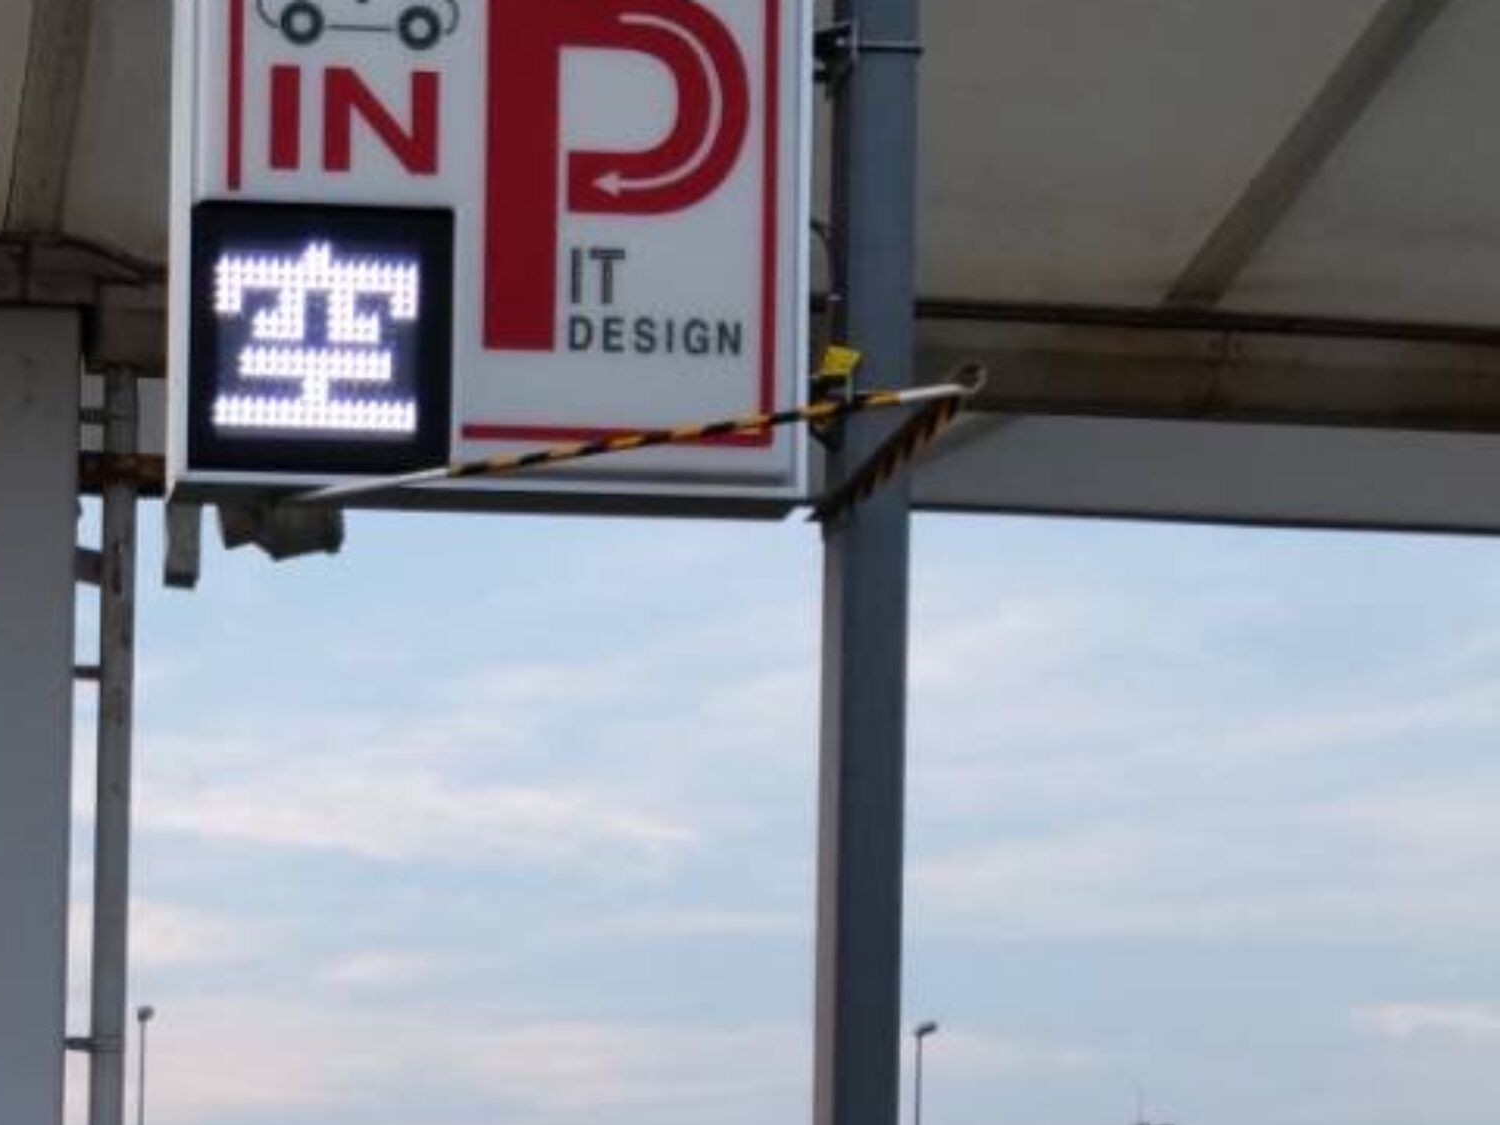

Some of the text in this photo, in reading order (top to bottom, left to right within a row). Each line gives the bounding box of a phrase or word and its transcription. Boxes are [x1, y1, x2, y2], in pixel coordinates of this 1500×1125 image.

[270, 65, 441, 175] IN
[570, 247, 626, 304] IT
[213, 240, 420, 433] 空
[569, 315, 742, 356] DESIGN
